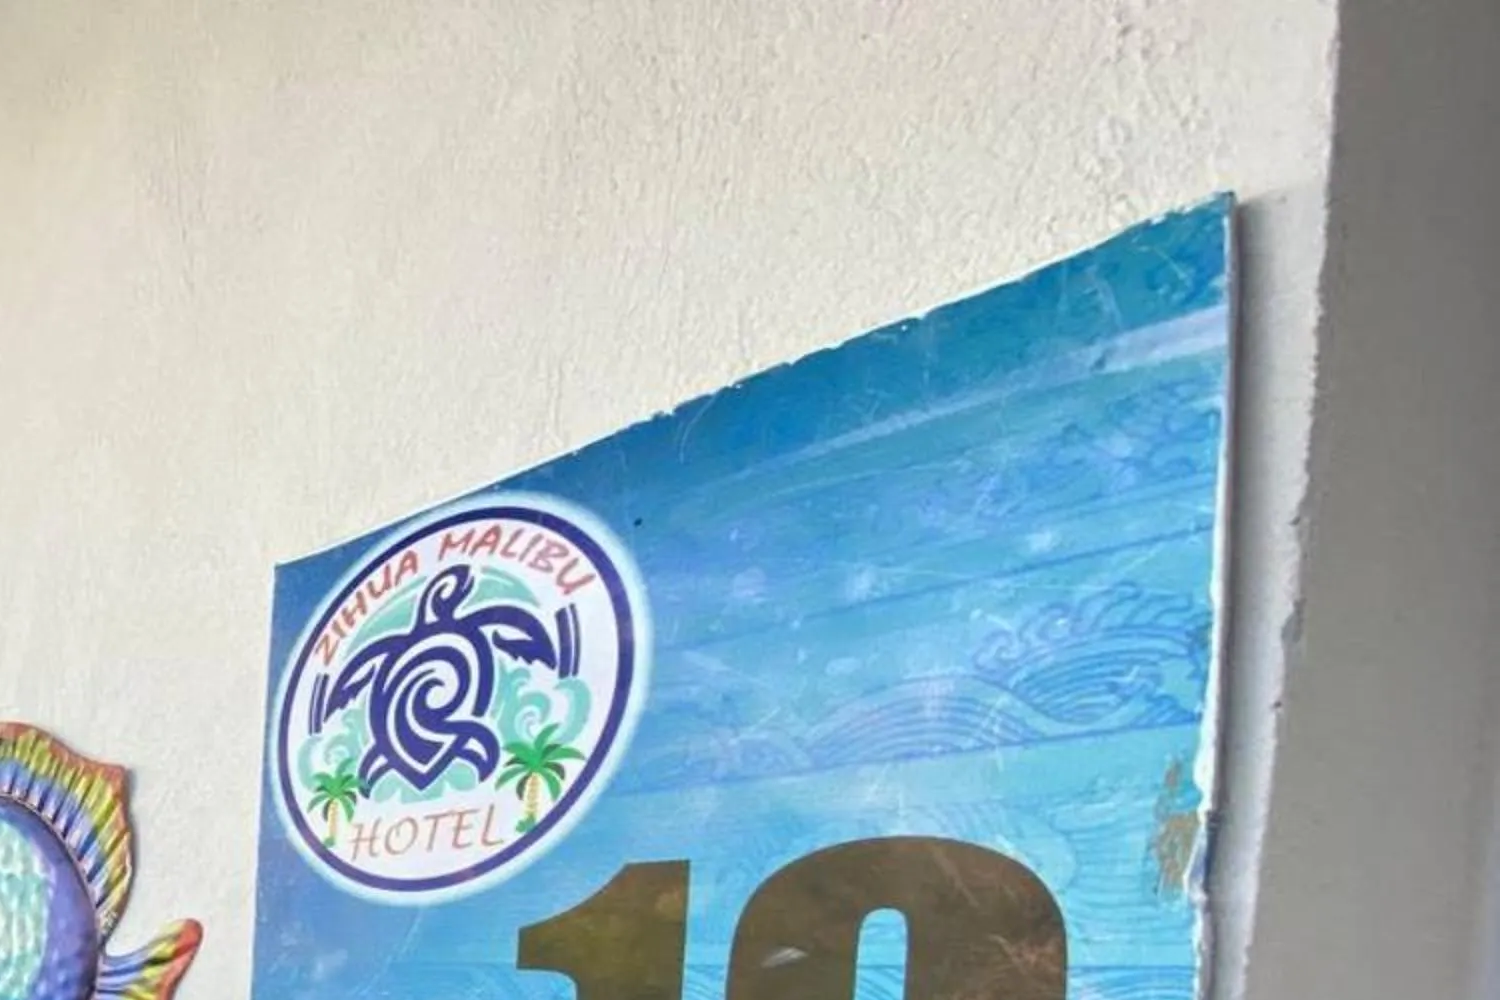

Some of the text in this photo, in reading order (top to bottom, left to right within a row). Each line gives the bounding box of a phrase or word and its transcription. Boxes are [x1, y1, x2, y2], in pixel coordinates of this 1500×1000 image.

[315, 524, 596, 666] ZIHUA MALIBU
[348, 803, 504, 861] HOTEL
